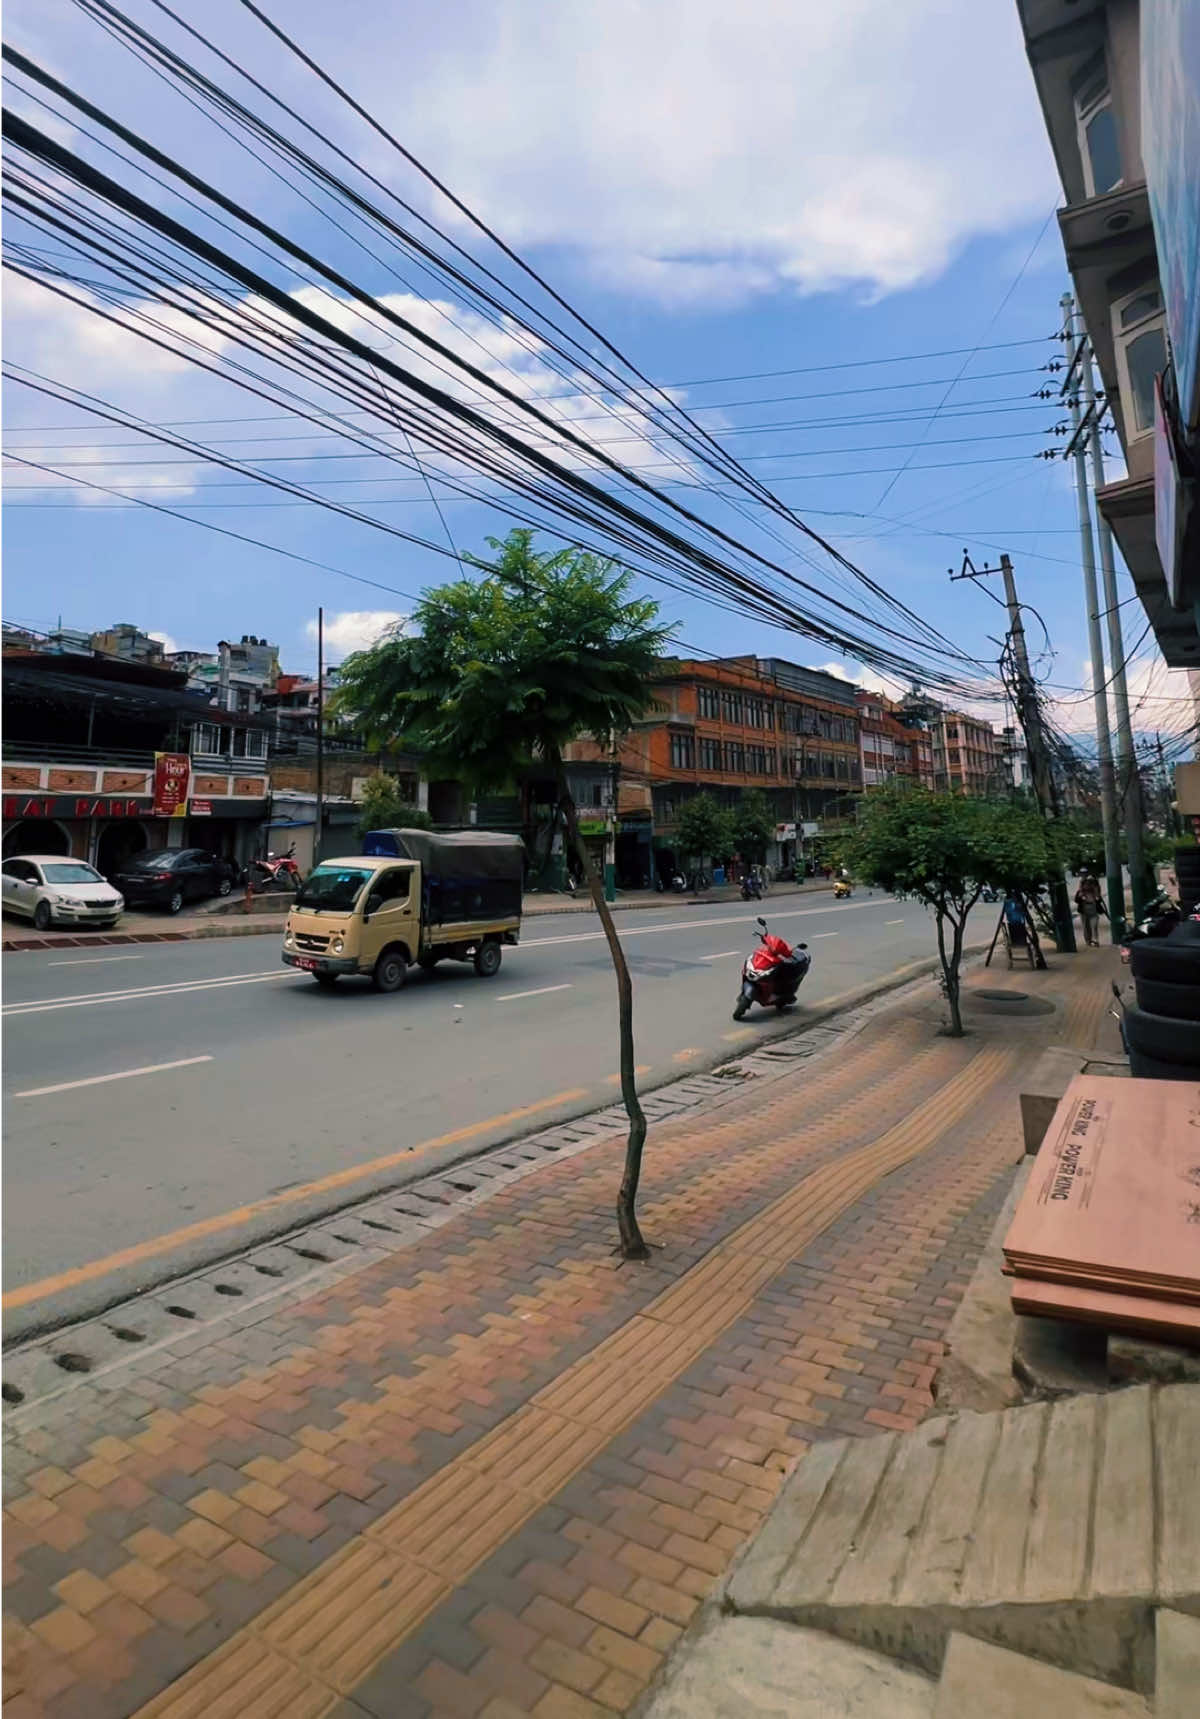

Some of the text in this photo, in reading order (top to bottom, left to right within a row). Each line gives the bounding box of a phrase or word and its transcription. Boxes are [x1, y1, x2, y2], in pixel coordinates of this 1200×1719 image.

[75, 799, 136, 817] PARK
[1078, 1100, 1096, 1119] POWER
[1071, 1120, 1089, 1136] KING
[1059, 1144, 1082, 1175] POWER
[1050, 1175, 1073, 1200] KING
